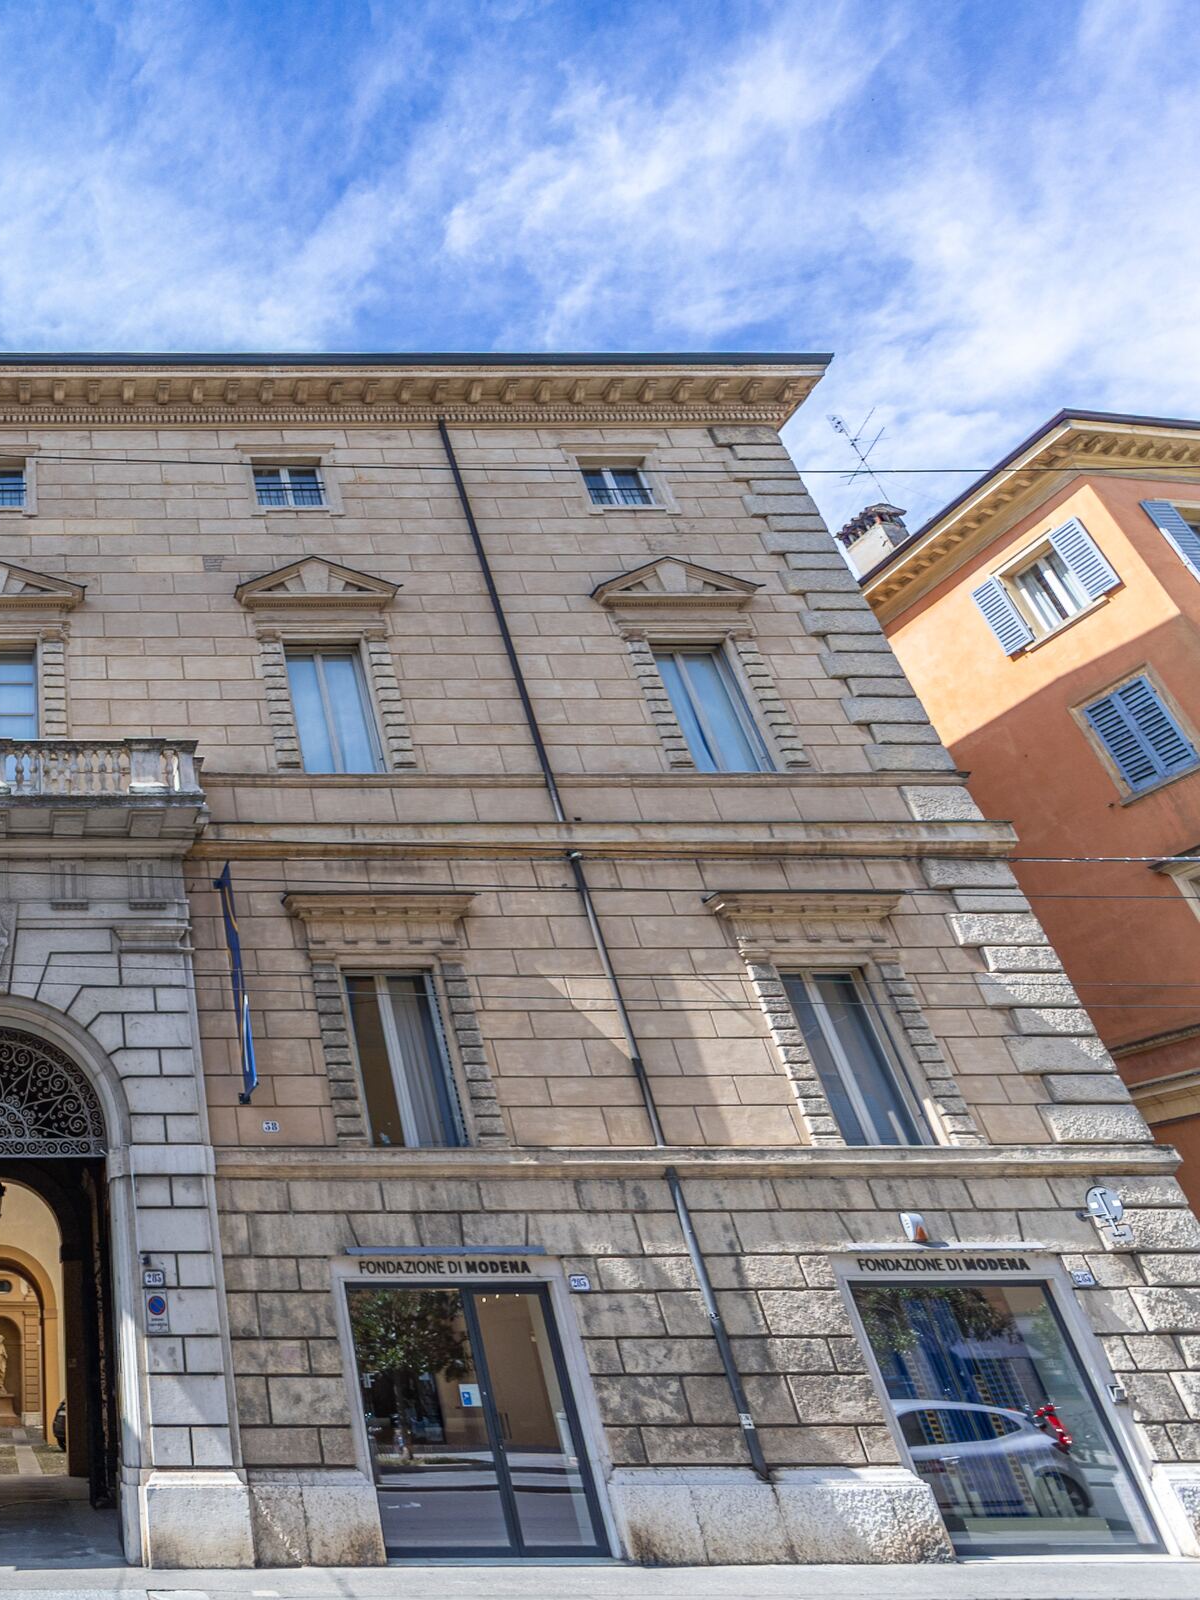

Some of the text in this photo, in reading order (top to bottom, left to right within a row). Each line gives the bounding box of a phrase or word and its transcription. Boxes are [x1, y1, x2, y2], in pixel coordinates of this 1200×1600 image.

[359, 1260, 532, 1275] FONDAZIONE DI MODENA
[856, 1257, 1031, 1272] FONDAZIONE DI MODENA
